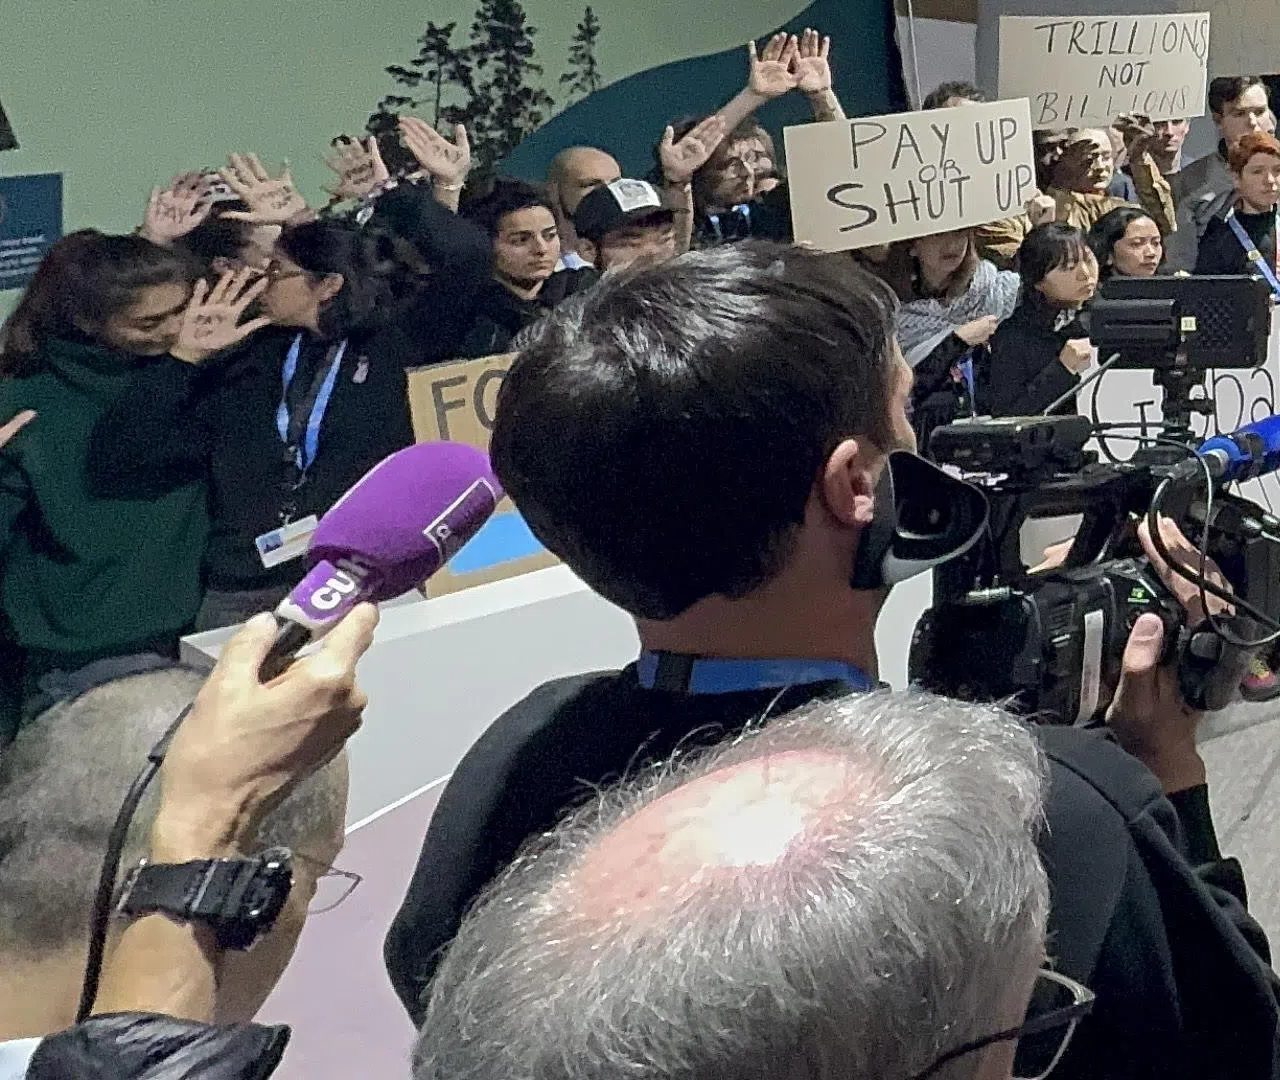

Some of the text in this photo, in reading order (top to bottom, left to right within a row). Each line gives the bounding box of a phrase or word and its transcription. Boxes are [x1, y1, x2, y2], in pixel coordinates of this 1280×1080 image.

[1034, 19, 1209, 64] TRILLIONS
[1098, 61, 1150, 89] NOT
[1036, 85, 1190, 124] BILLIONS
[850, 118, 1017, 169] PAY UP
[919, 159, 962, 184] OR
[827, 164, 1032, 232] SHUT UP
